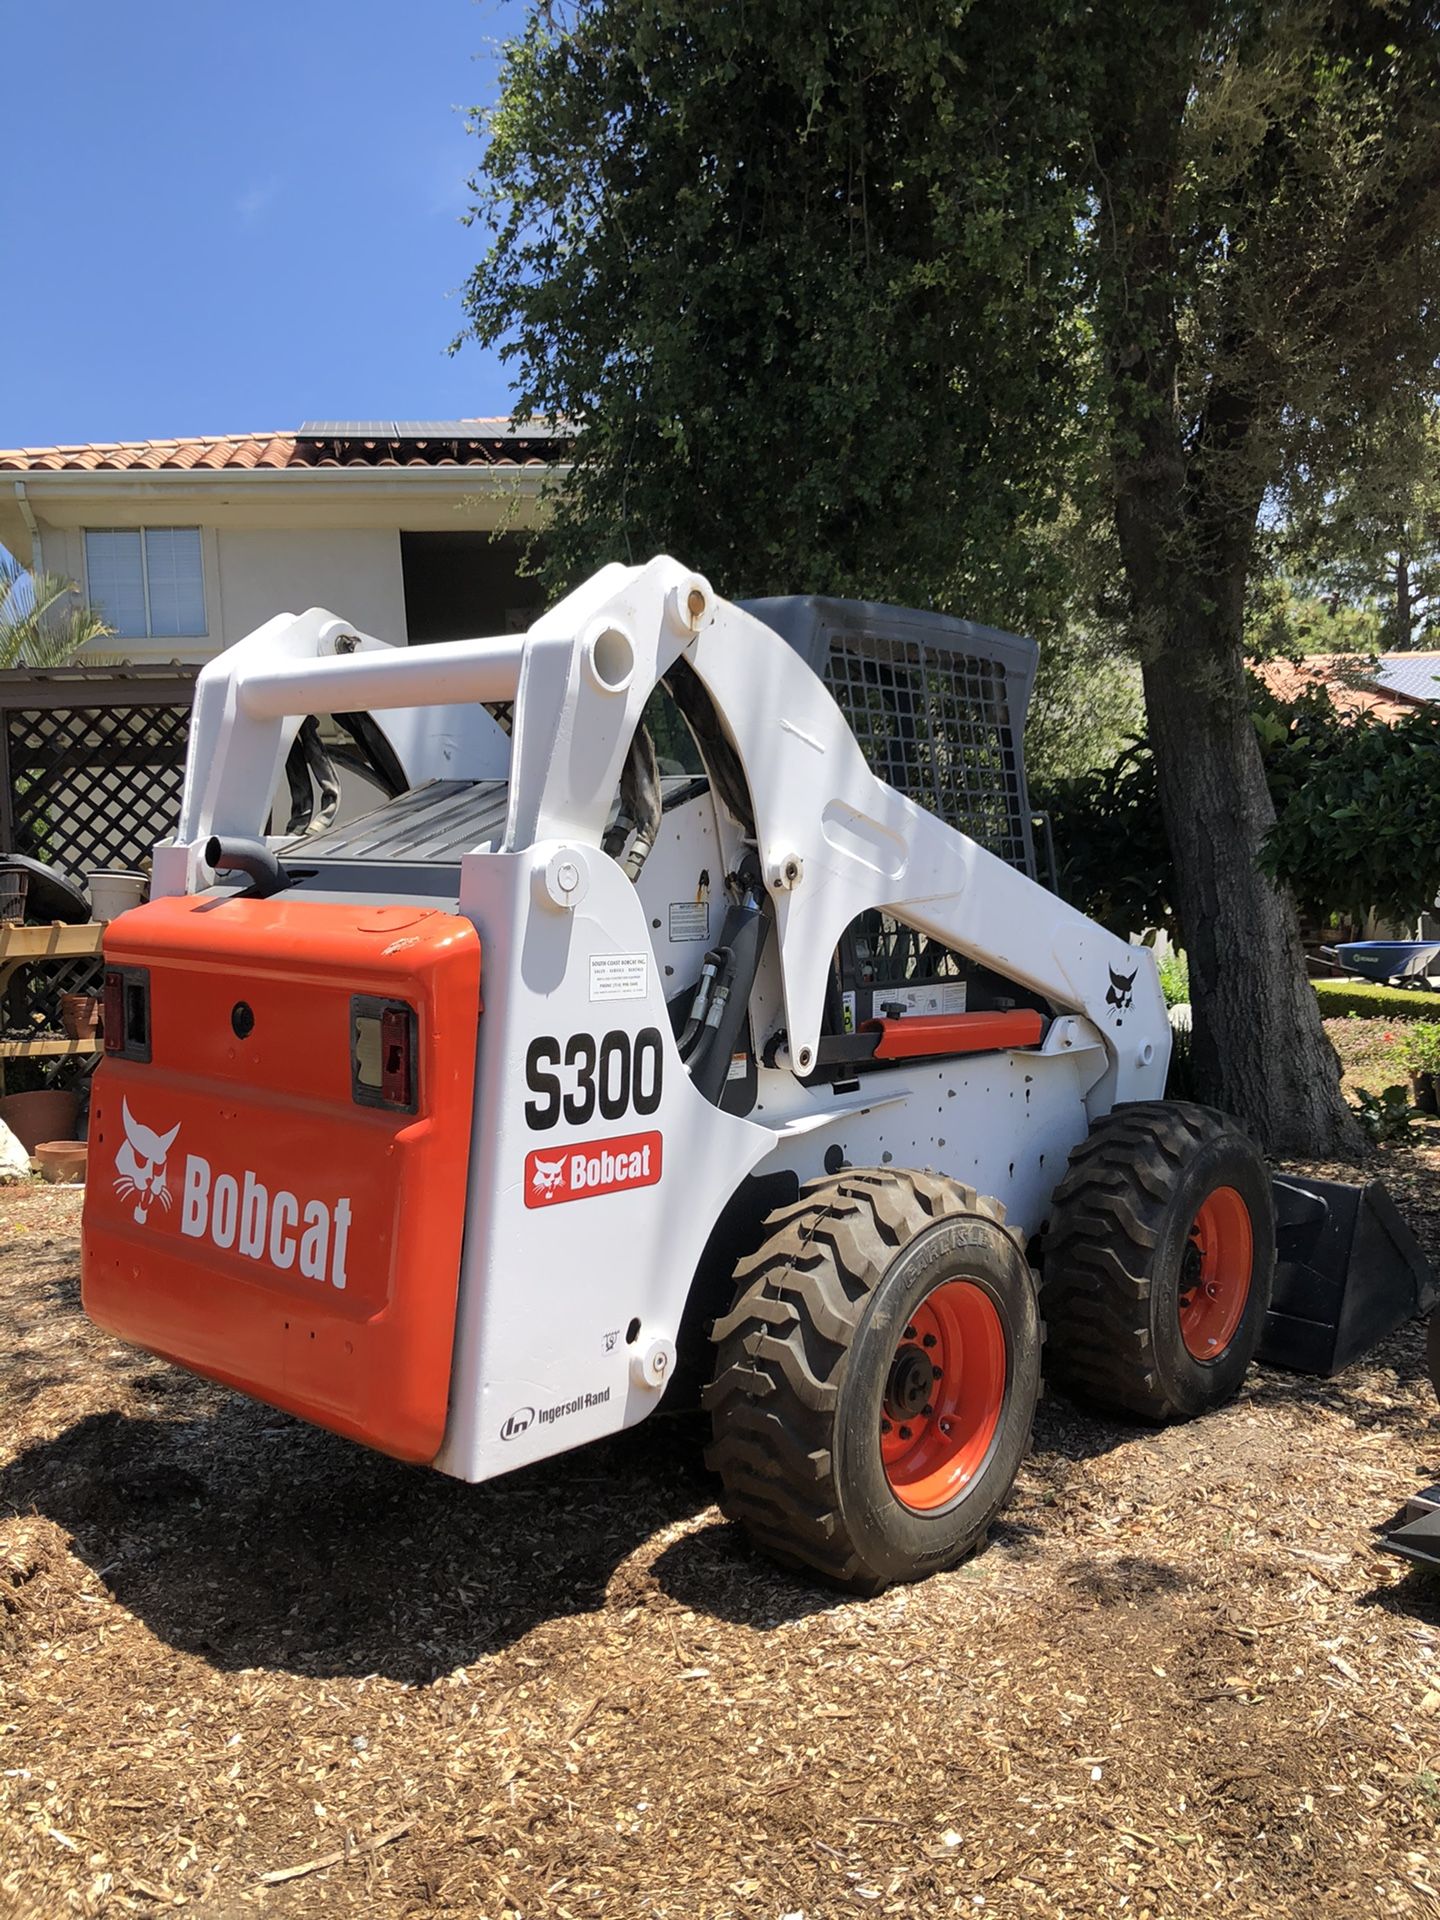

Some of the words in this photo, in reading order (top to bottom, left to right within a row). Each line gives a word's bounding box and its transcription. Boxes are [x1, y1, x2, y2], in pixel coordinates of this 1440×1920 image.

[525, 1027, 663, 1131] S300
[570, 1144, 650, 1190] Bobcat
[181, 1154, 352, 1289] Bobcat
[538, 1386, 611, 1424] Ingersoll-Rand
